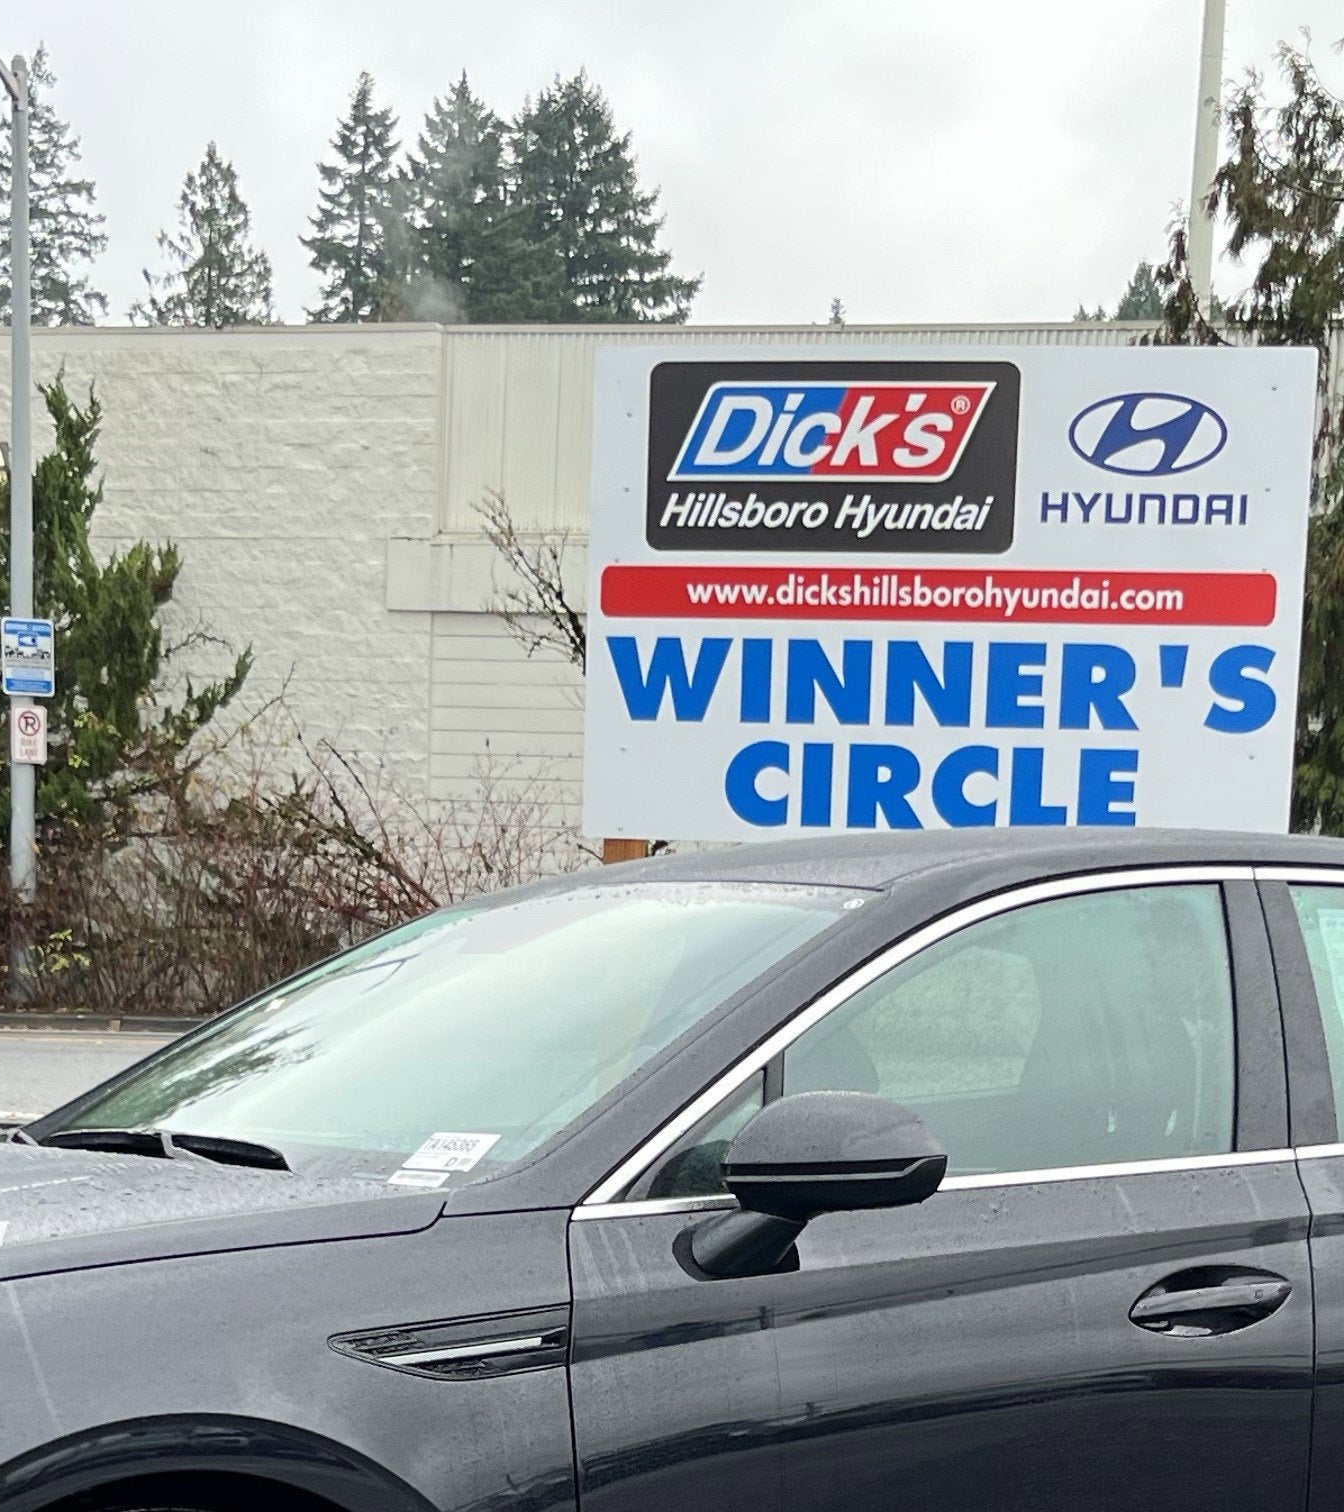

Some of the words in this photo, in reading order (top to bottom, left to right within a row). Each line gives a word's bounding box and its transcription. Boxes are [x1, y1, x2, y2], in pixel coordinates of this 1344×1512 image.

[693, 393, 954, 468] Dick's
[660, 492, 829, 528] Hillsboro
[834, 494, 994, 538] Hyundai
[1041, 492, 1248, 526] HYUNDAI
[687, 577, 1184, 616] www.dickshillsborohyundai.com
[606, 636, 1277, 734] WINNER'S
[724, 740, 1139, 830] CIRCLE
